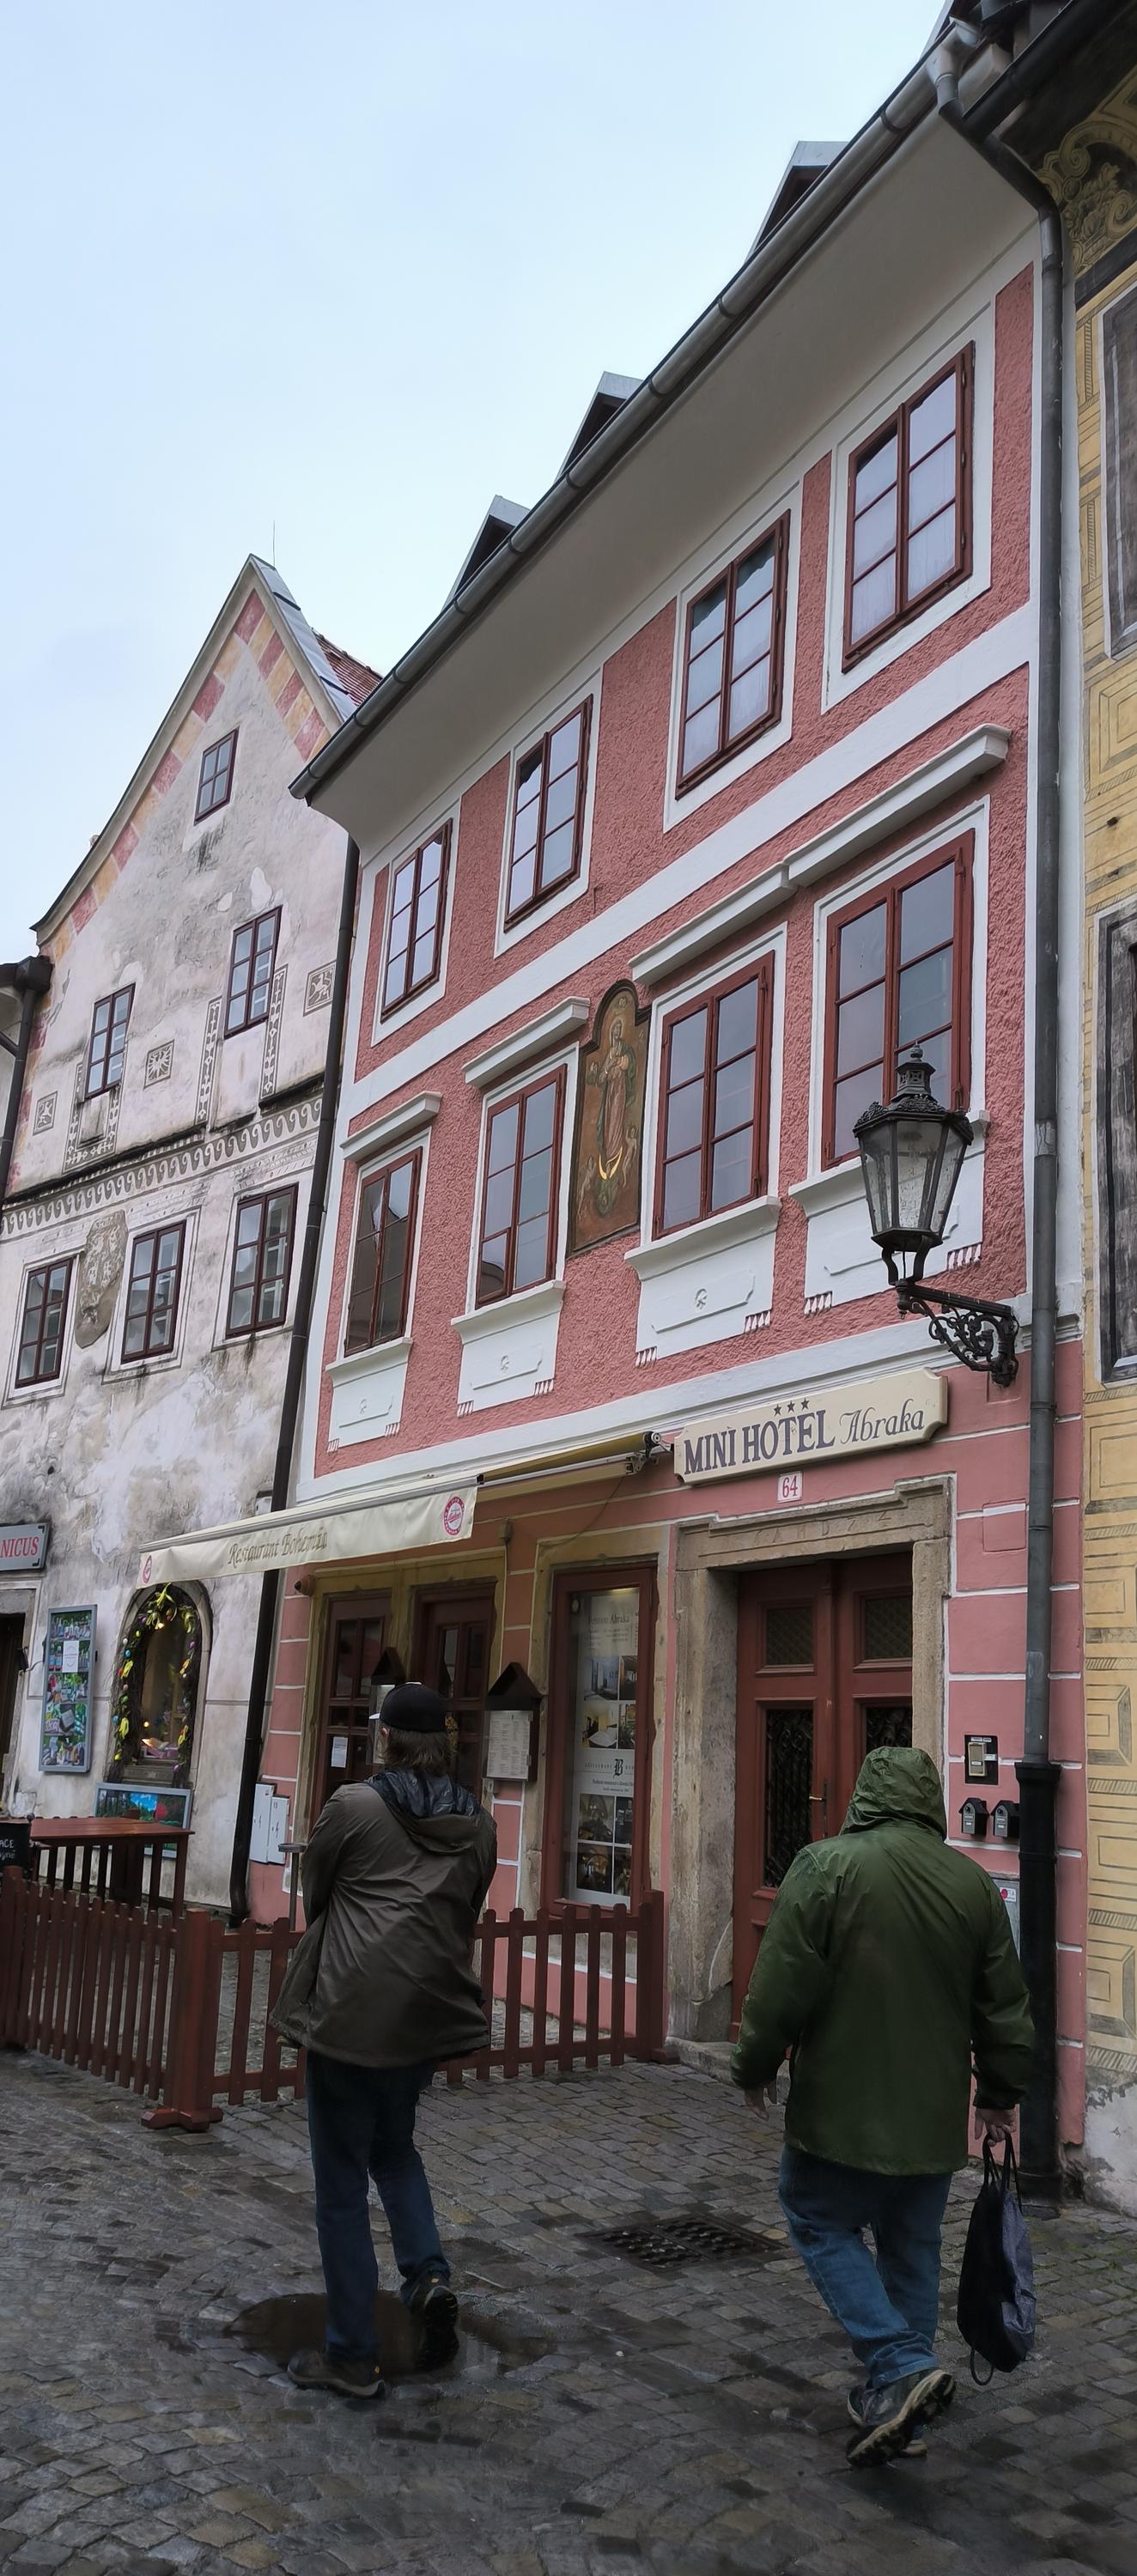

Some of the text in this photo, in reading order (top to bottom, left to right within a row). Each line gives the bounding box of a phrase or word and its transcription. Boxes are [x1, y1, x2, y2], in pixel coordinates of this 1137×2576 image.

[684, 1398, 925, 1475] MINI HOTEL Abraka
[781, 1476, 799, 1498] 64
[0, 1536, 40, 1558] NICUS
[228, 1538, 281, 1569] Restaurant
